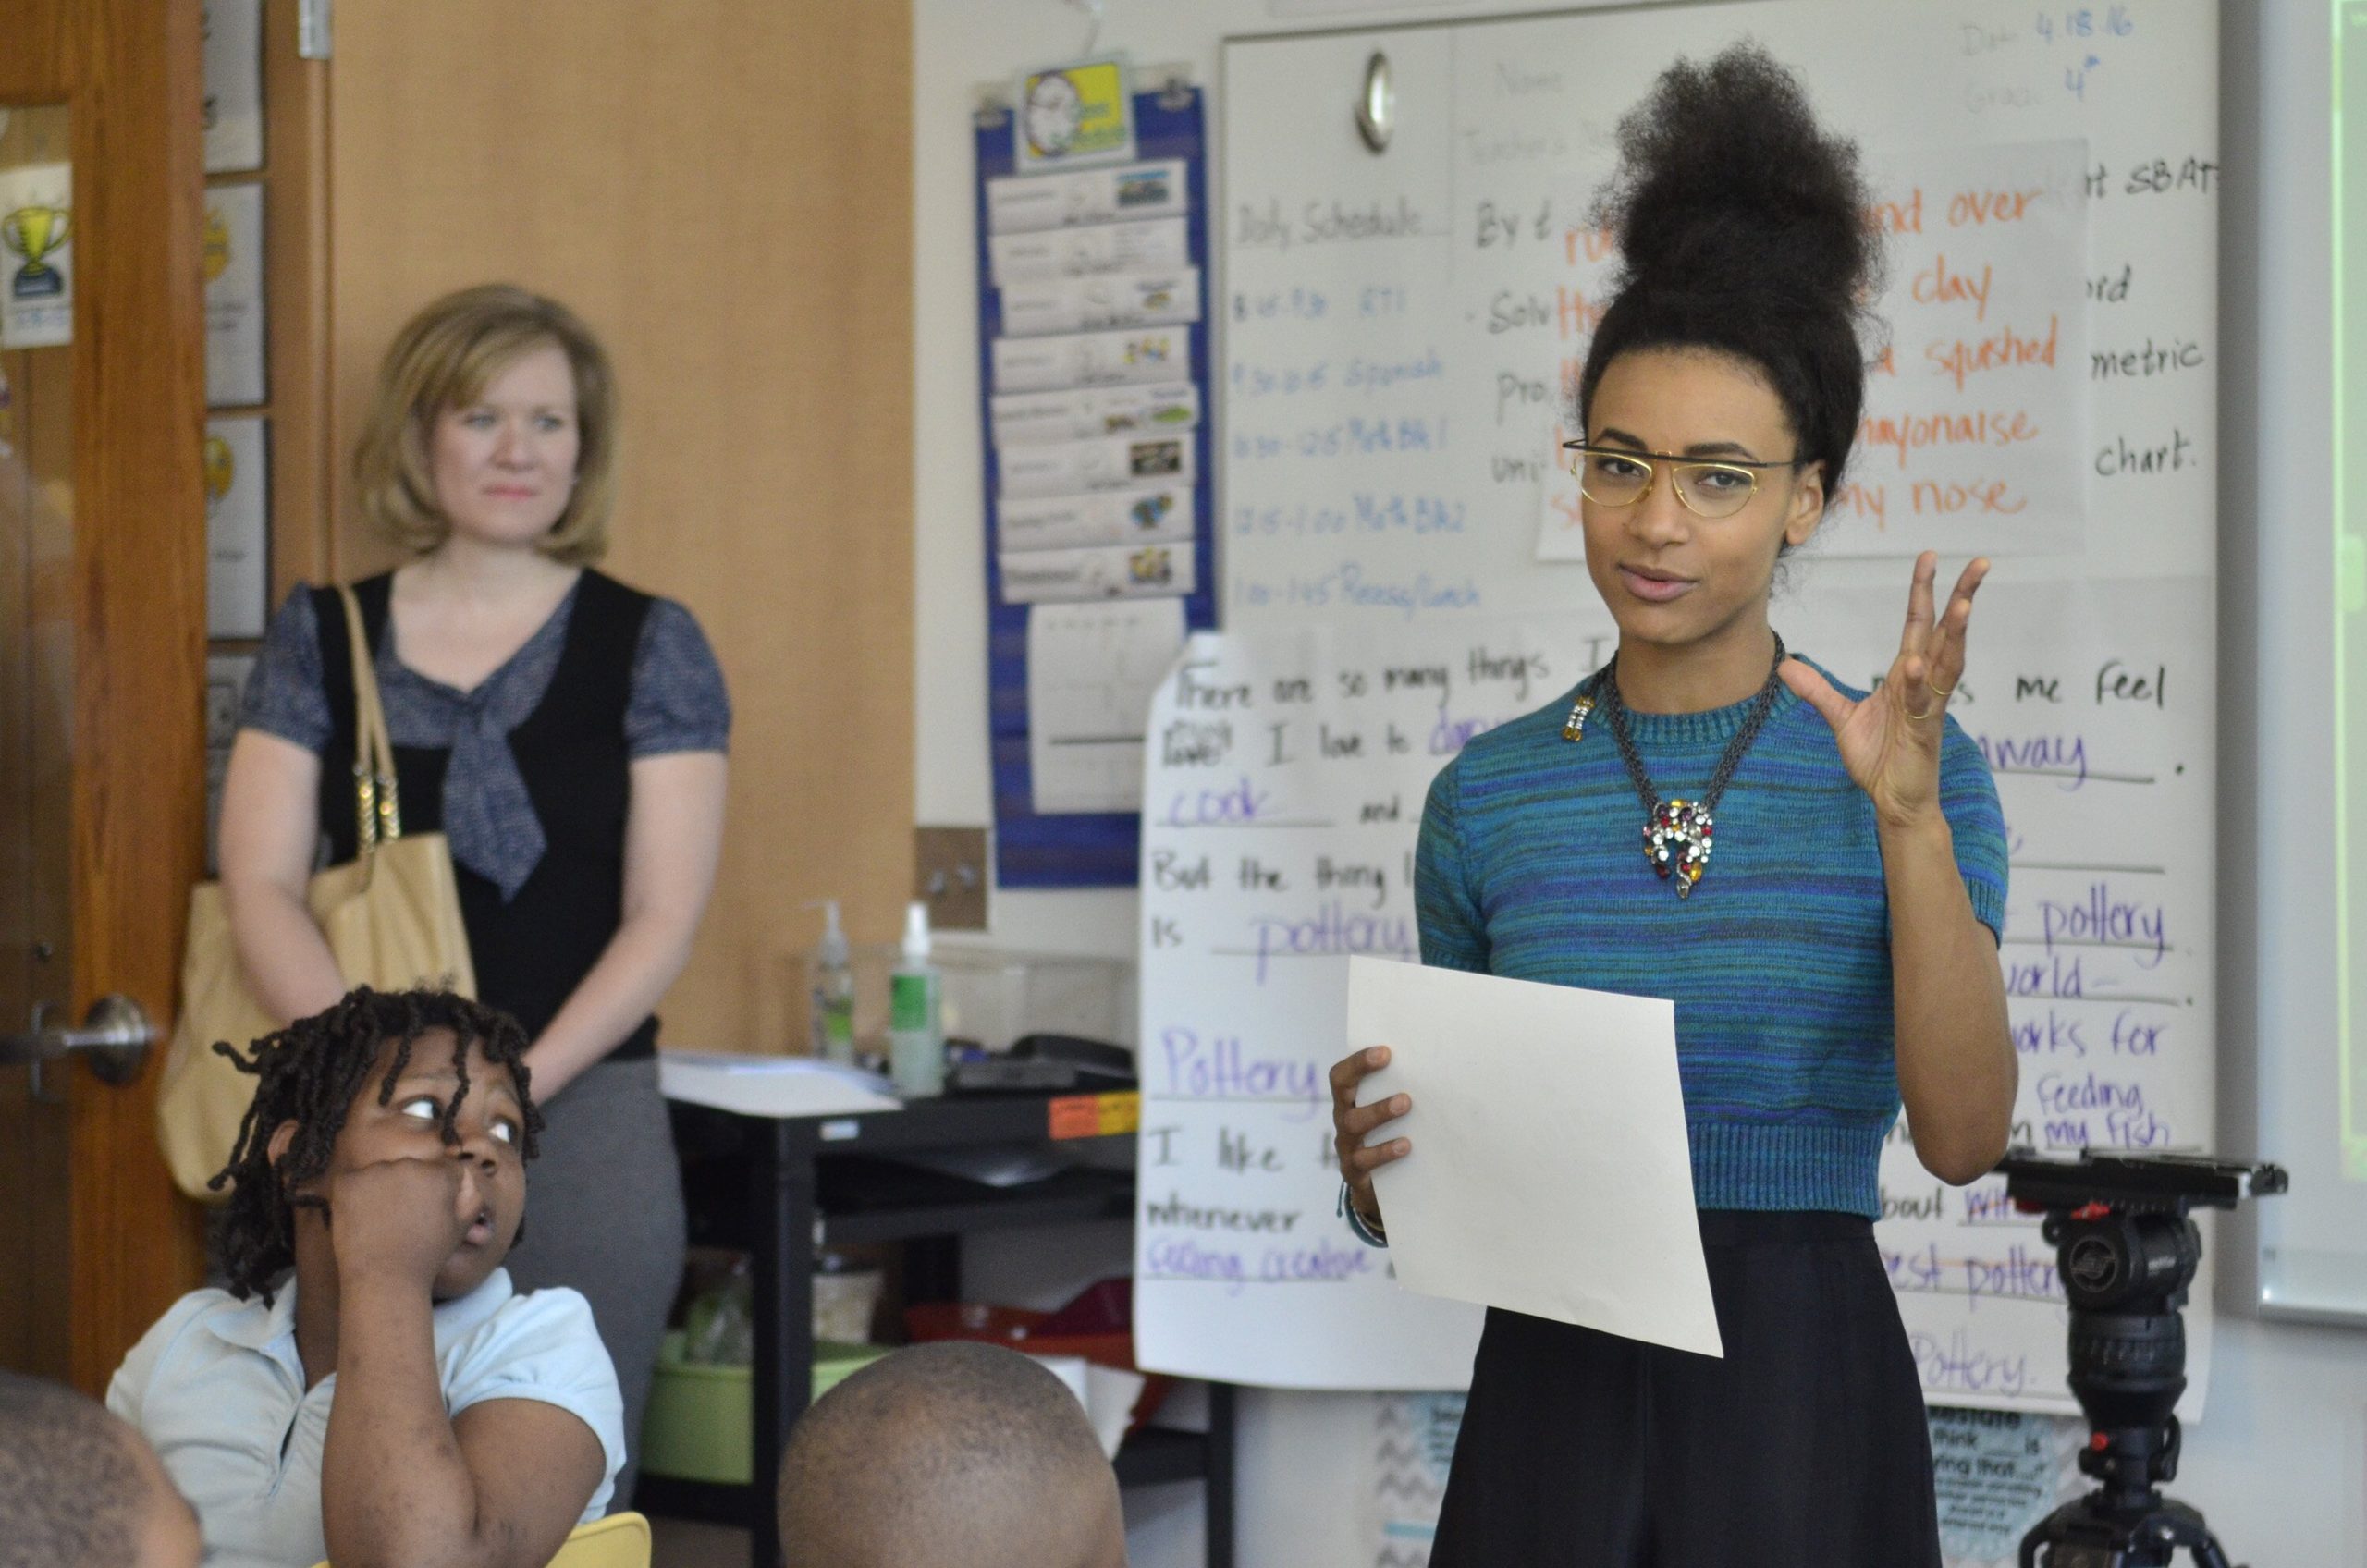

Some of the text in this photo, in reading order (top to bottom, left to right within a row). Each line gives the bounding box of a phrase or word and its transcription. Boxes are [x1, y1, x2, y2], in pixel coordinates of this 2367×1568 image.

[1947, 188, 2044, 228] over
[1911, 251, 1993, 323] clay
[2091, 338, 2205, 380] metric
[1911, 478, 2028, 516] nose
[1273, 676, 1315, 705] are
[1383, 662, 1451, 707] many
[1468, 646, 1551, 701] things
[2015, 675, 2062, 703] me
[1266, 720, 1297, 768] I
[1360, 792, 1401, 825] and
[1152, 849, 1211, 891] But
[1238, 857, 1289, 892] the
[1317, 856, 1387, 910] thing
[2039, 882, 2165, 969] pottery
[1161, 1026, 1320, 1122] Pottery
[1150, 1124, 1184, 1168] I
[1218, 1126, 1286, 1176] like
[1964, 1243, 2065, 1313] potter
